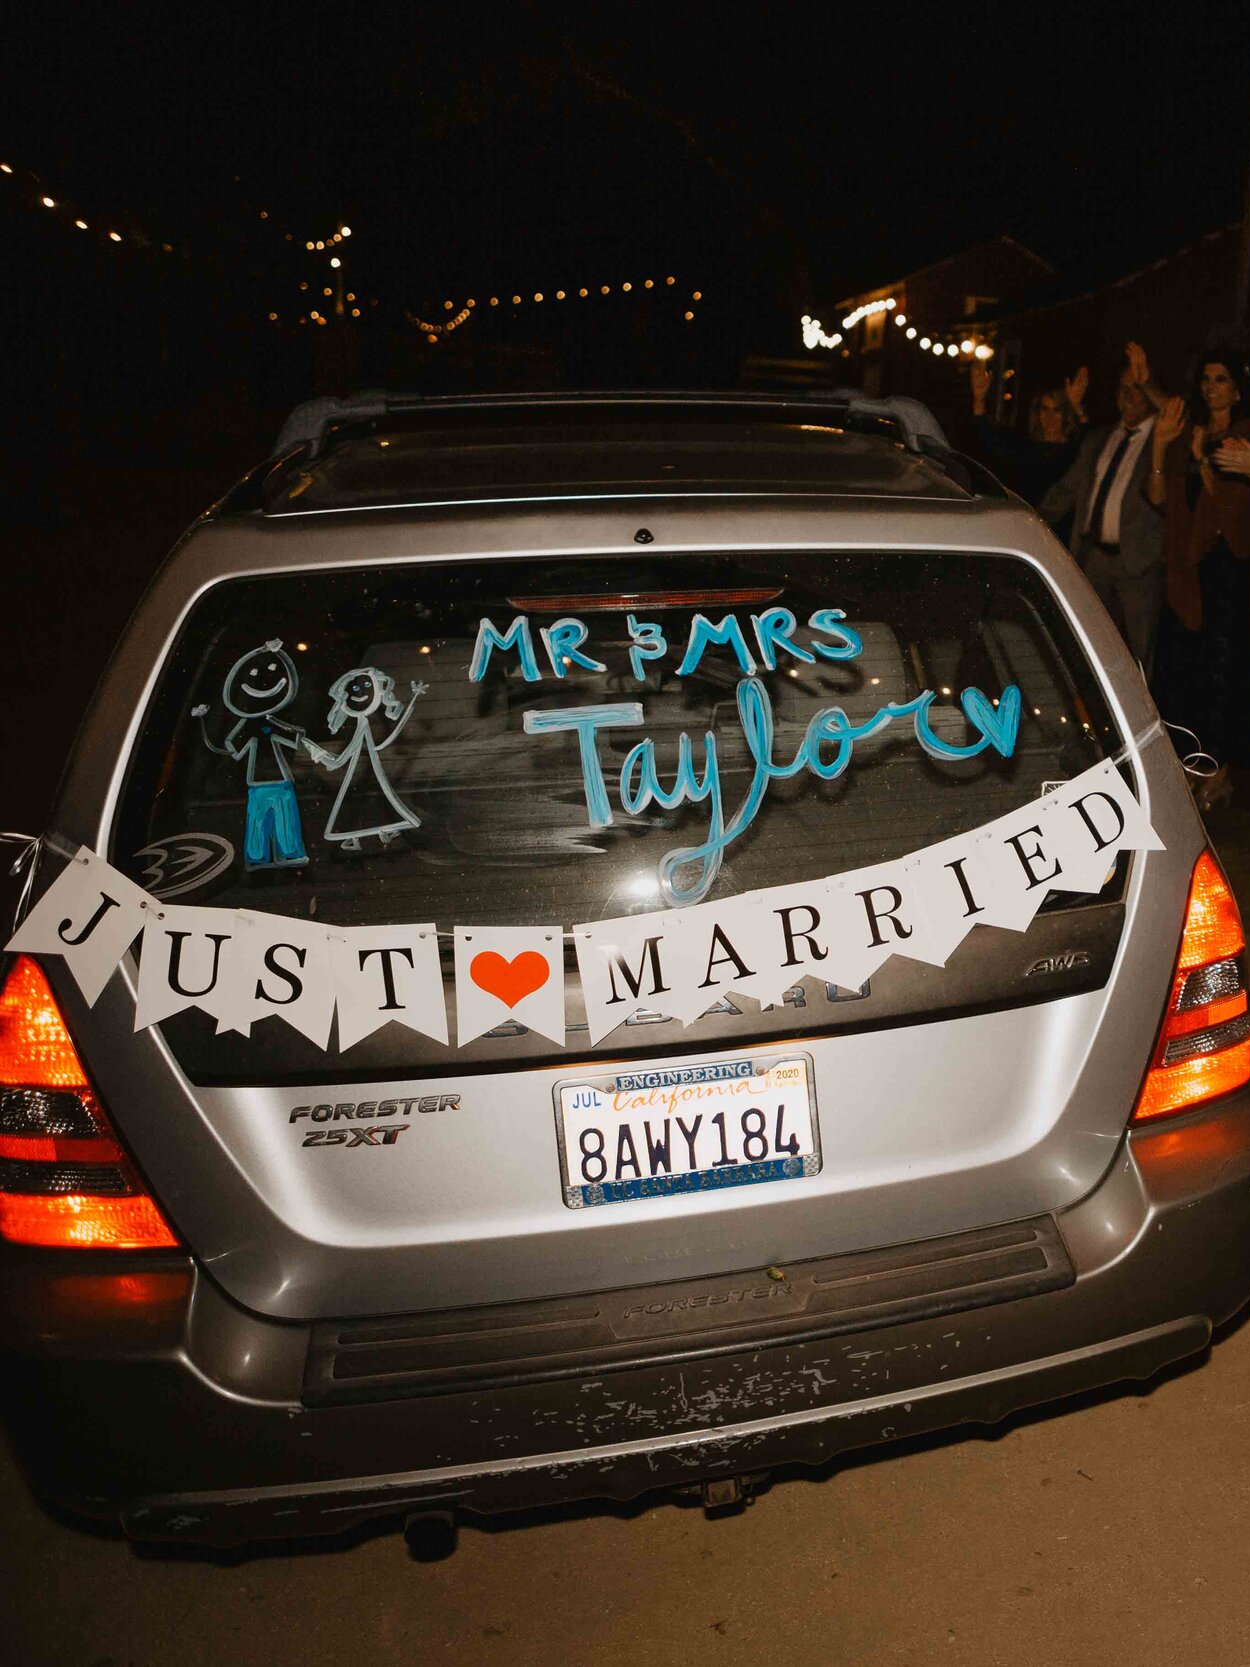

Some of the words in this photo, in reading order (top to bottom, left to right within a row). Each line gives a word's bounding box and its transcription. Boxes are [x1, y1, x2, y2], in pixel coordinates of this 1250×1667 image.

[468, 615, 607, 683] MR
[674, 608, 863, 675] MRS
[523, 676, 993, 907] Taylor
[603, 789, 1126, 1005] MARRIED
[57, 891, 416, 1012] JUST
[618, 1063, 751, 1091] ENGINEERING
[776, 1068, 800, 1080] 2020
[289, 1093, 462, 1124] FORESTER
[572, 1091, 602, 1109] JUL
[611, 1079, 767, 1114] California
[578, 1104, 801, 1184] 8AWY184
[639, 1173, 695, 1195] SANTA
[699, 1161, 779, 1187] BARBARA
[624, 1283, 793, 1319] FORESTER
